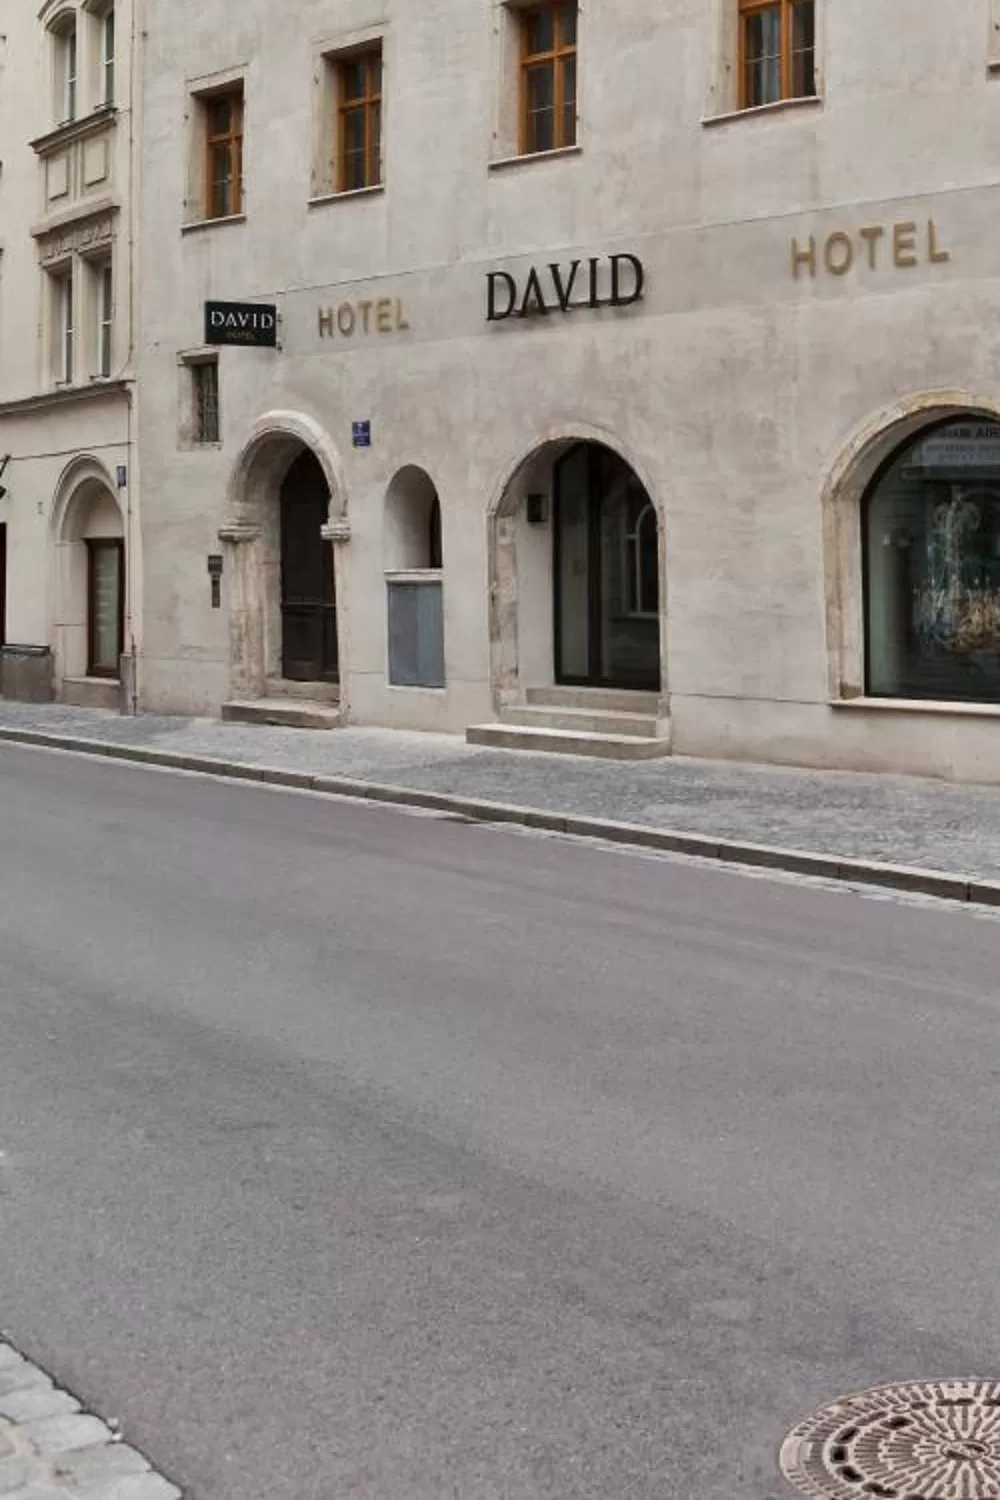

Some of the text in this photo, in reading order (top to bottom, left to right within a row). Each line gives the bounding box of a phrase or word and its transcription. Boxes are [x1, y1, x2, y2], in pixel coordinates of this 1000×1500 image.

[317, 218, 950, 339] HOTEL DAVID HOTEL
[210, 310, 273, 329] DAVID
